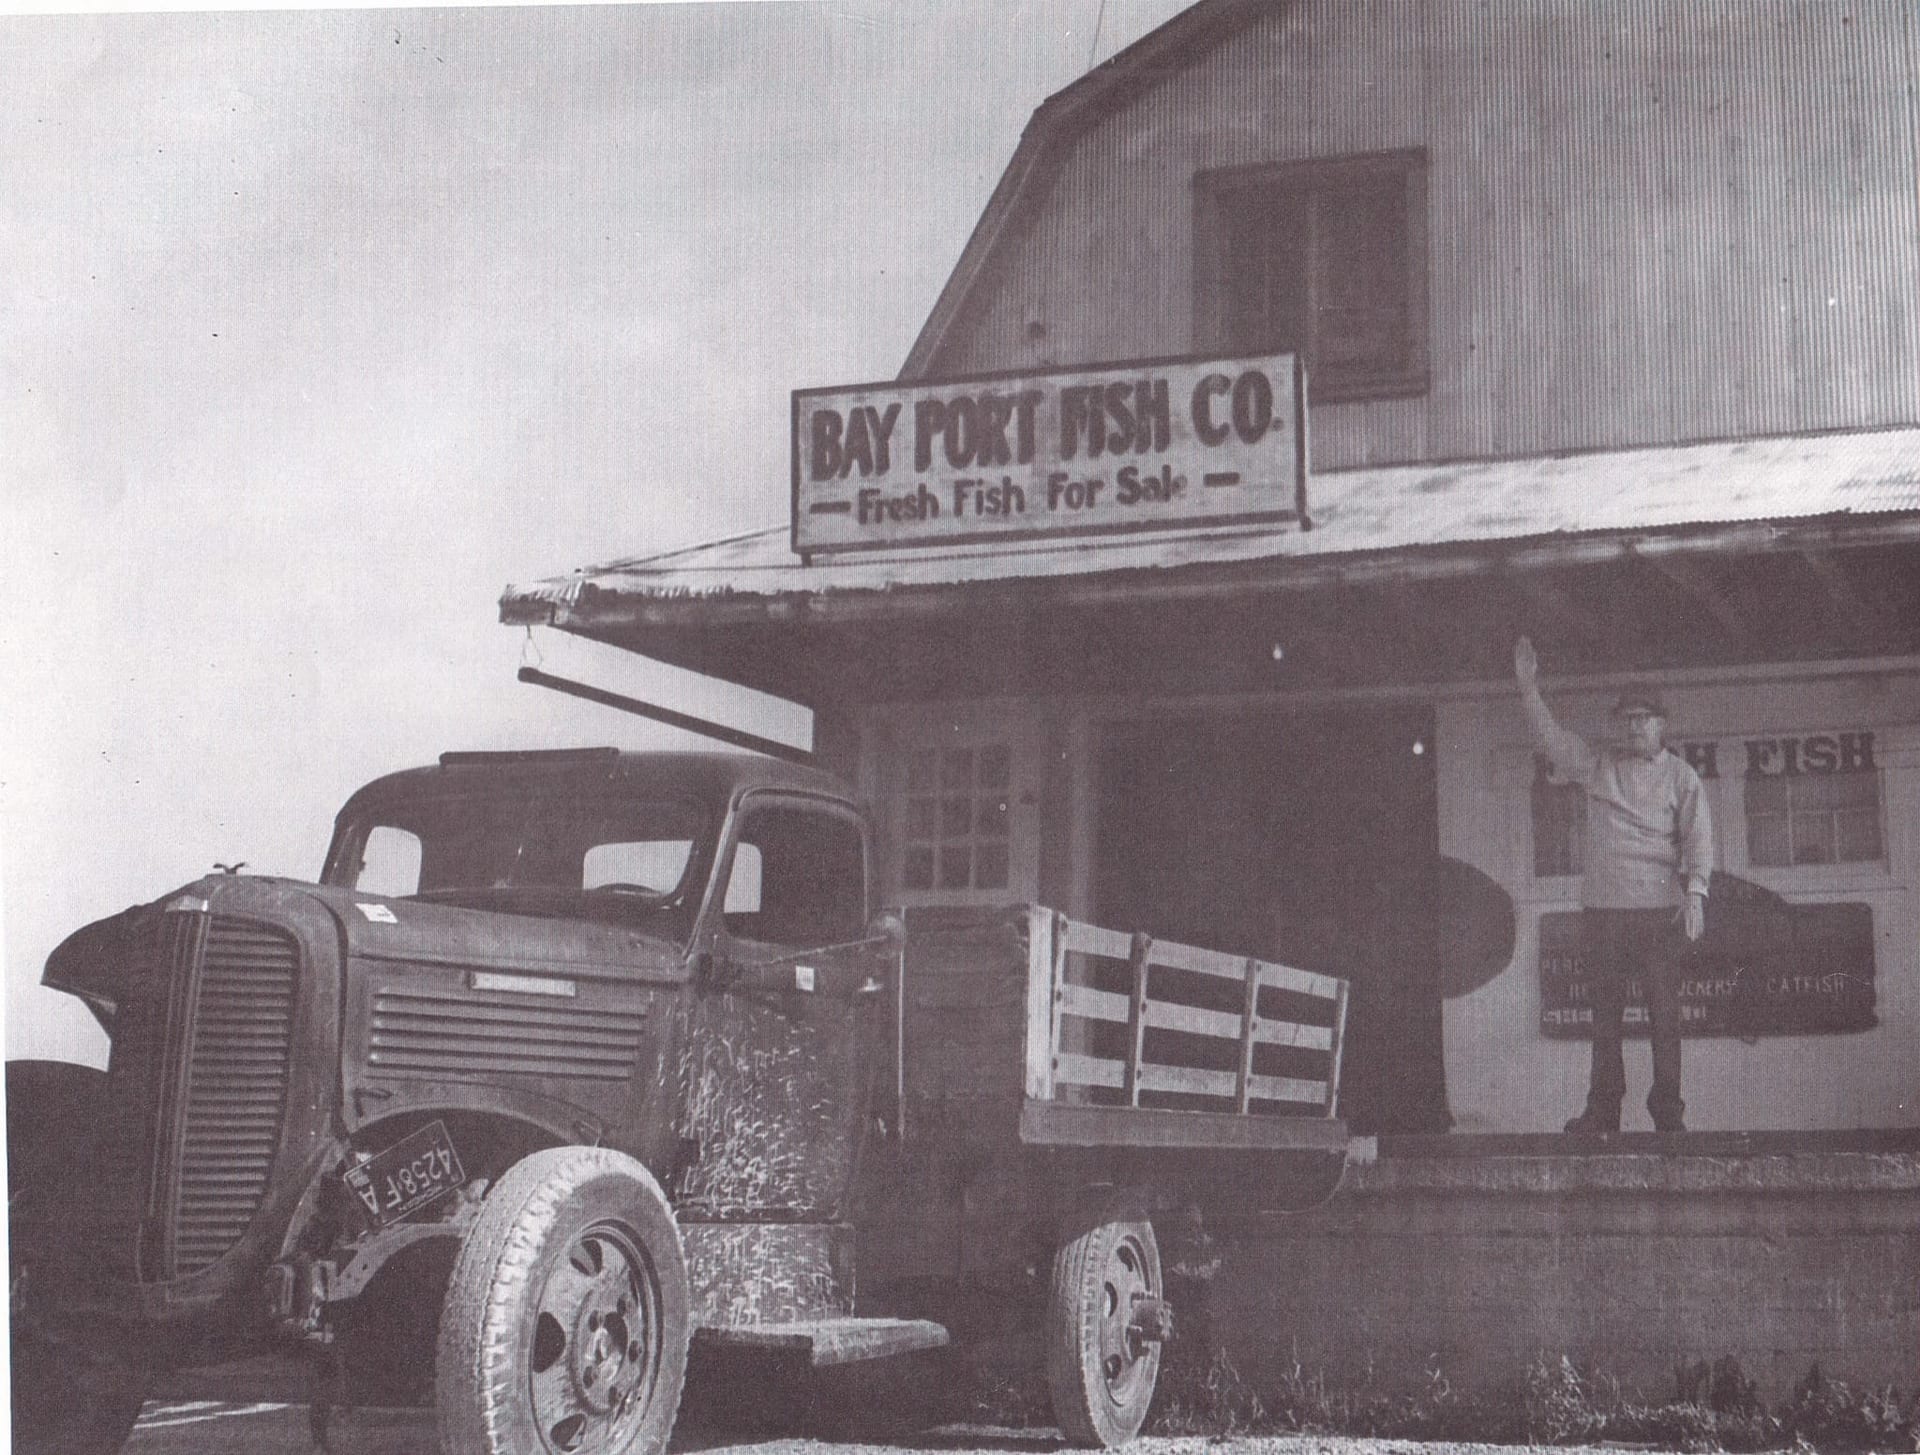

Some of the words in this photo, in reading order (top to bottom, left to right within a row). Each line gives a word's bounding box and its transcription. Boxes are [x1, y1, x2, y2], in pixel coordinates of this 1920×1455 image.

[811, 401, 902, 482] BAY
[913, 389, 1045, 474] PORT
[1060, 378, 1170, 462] FISH
[858, 483, 939, 525] Fresh
[953, 475, 1026, 518] Fish
[1047, 471, 1105, 512] For
[1116, 464, 1188, 506] Sale
[1743, 731, 1876, 778] FISH
[1766, 974, 1845, 995] CATFISH
